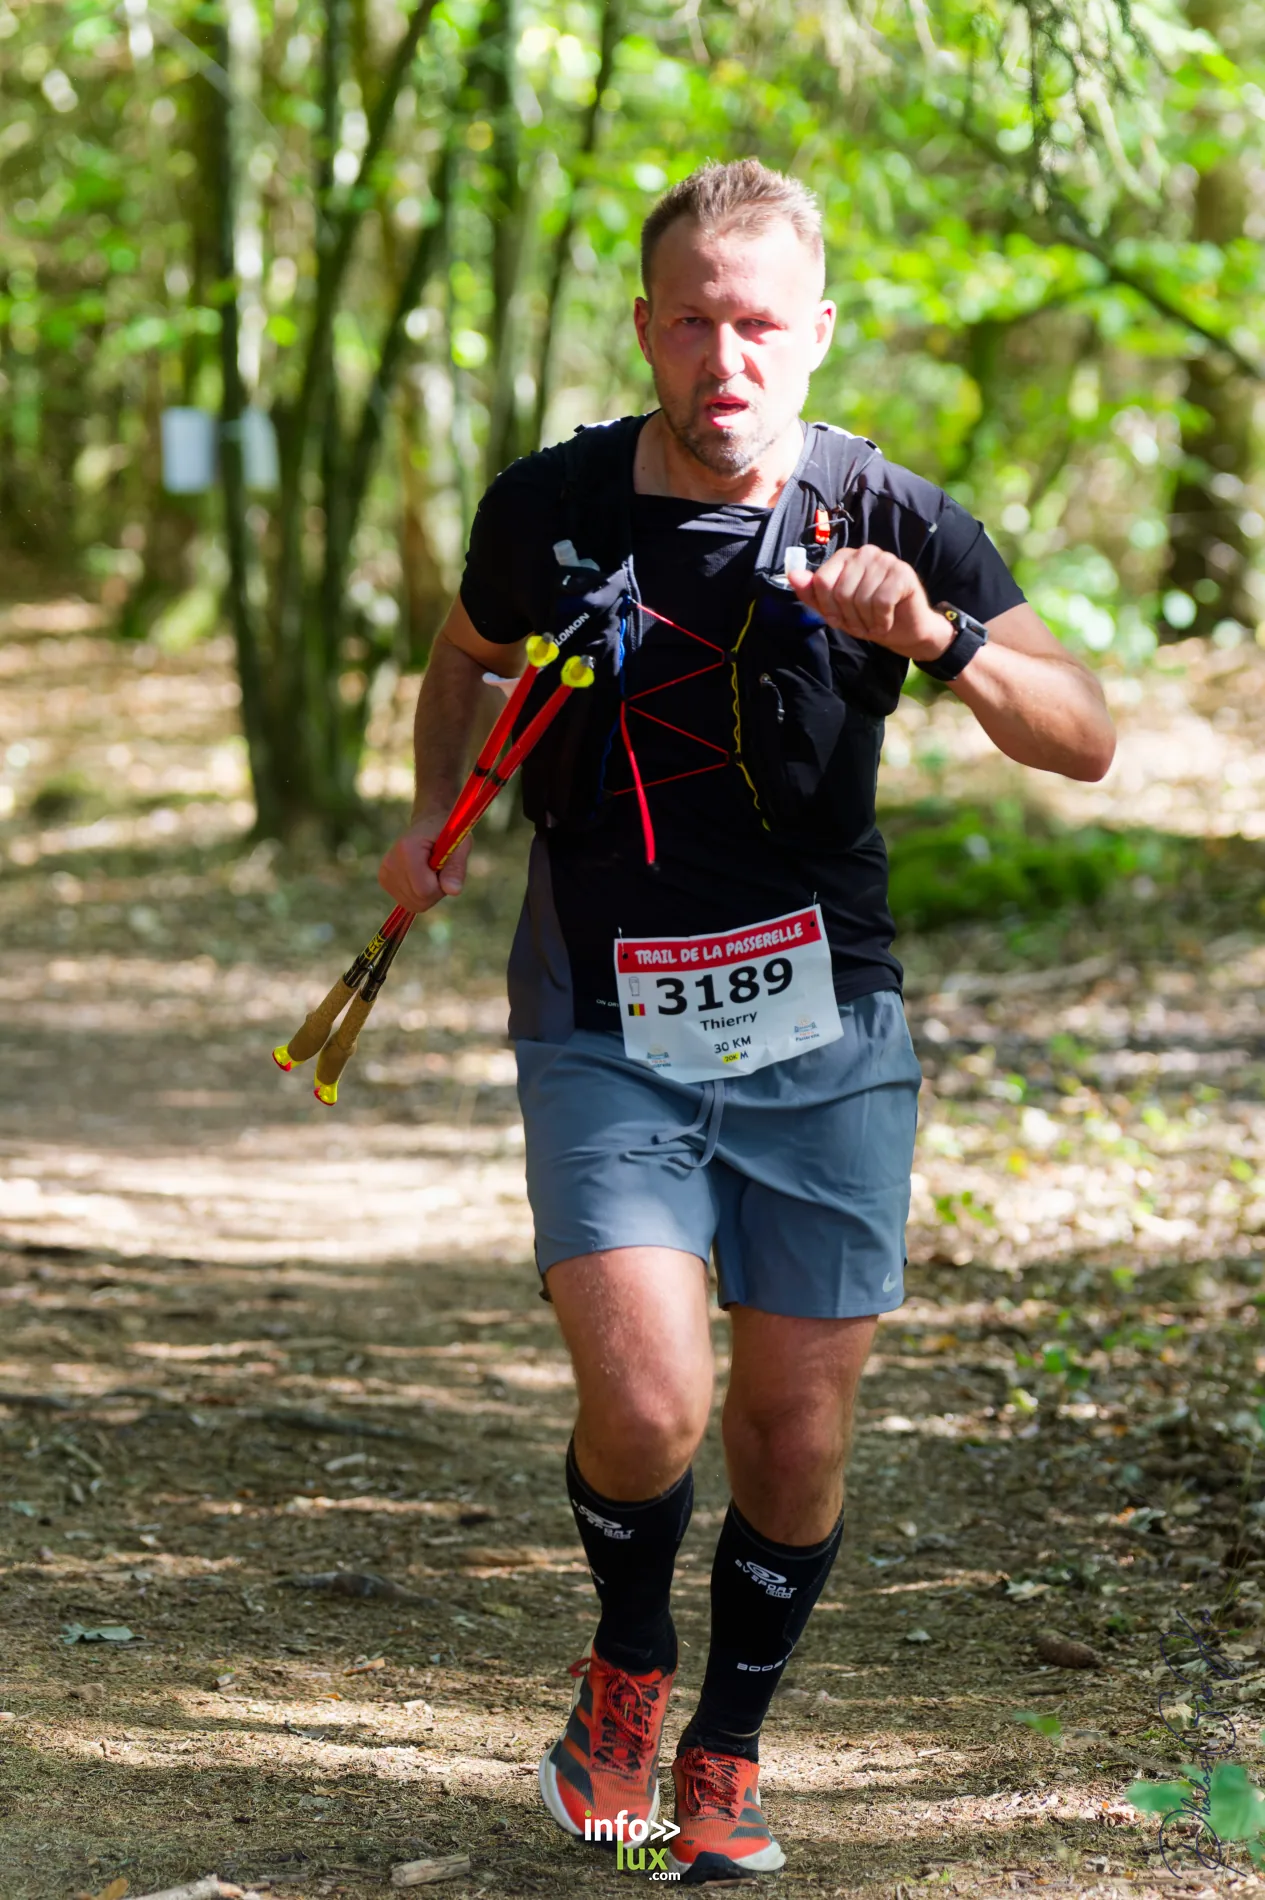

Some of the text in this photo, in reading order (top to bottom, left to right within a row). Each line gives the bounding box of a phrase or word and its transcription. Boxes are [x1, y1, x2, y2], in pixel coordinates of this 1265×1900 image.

[554, 612, 590, 647] LOMON
[634, 921, 803, 966] TRAIL DE LA PASSERELLE
[655, 957, 793, 1016] 3189
[700, 1011, 758, 1032] Thierry
[714, 1035, 752, 1054] 30 KM
[740, 1050, 749, 1060] M
